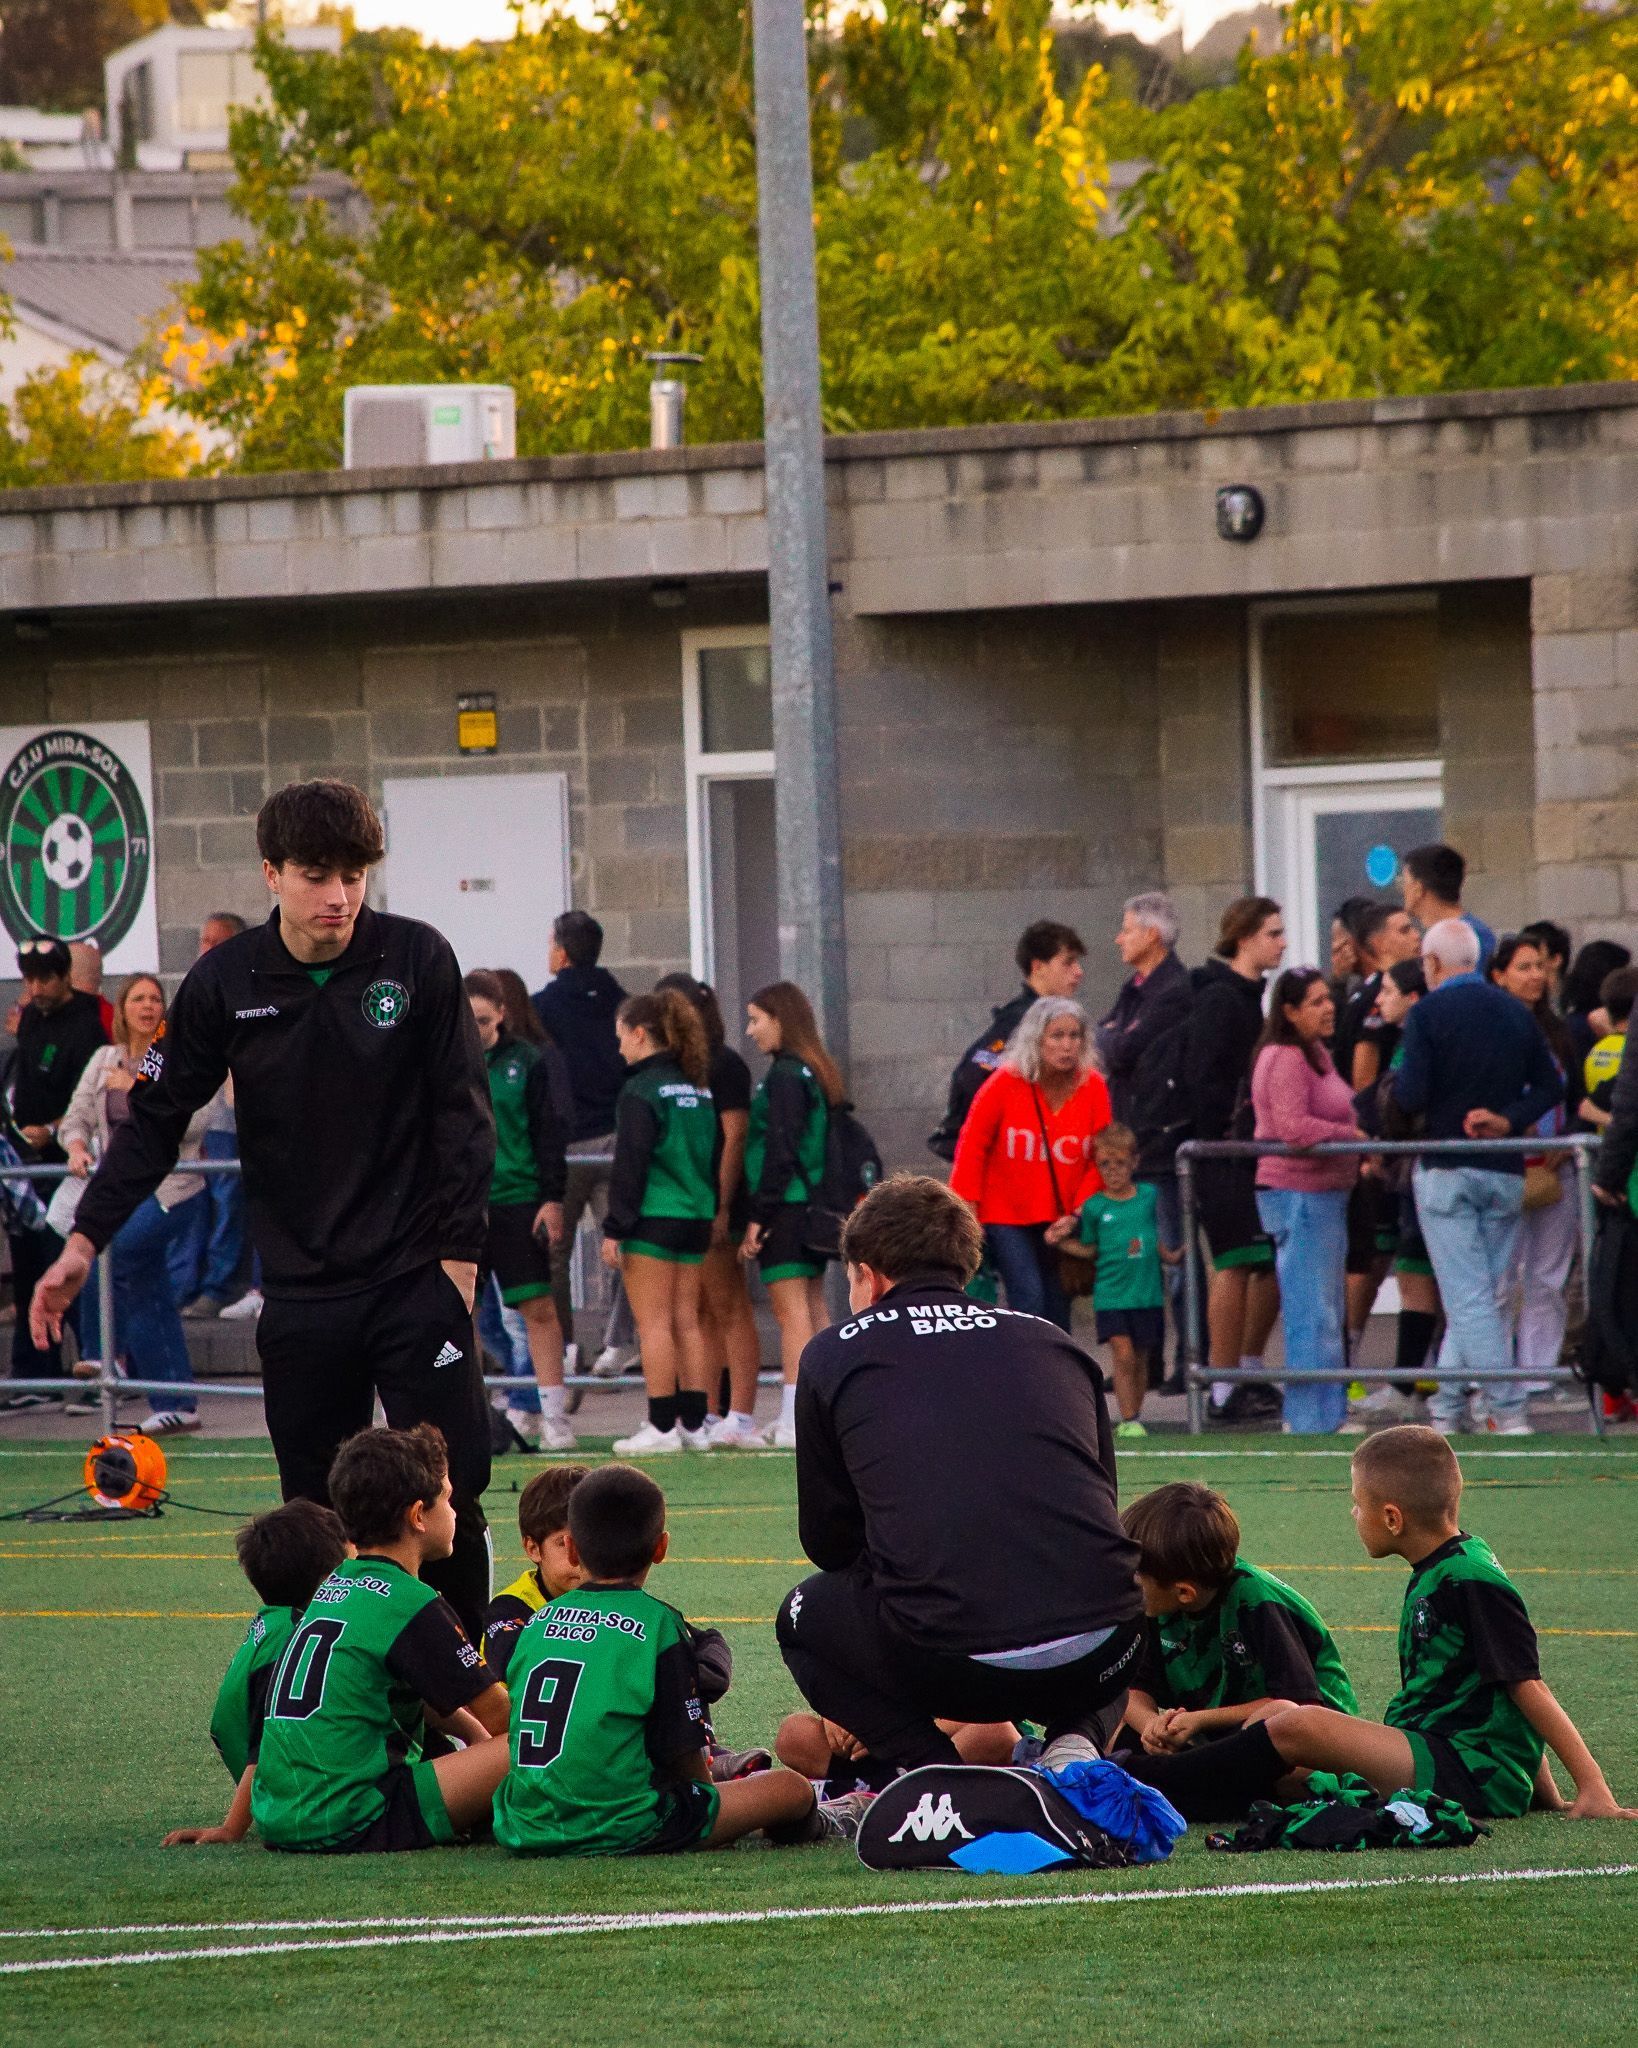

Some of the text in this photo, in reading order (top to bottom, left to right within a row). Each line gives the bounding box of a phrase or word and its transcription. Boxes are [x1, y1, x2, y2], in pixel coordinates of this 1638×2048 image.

[45, 736, 121, 783] MIRA-SOL
[839, 1309, 899, 1340] CFU
[911, 1316, 997, 1336] BACO
[313, 1587, 350, 1603] BACO
[544, 1622, 597, 1643] BACO
[552, 1606, 646, 1642] MIRA-SOL
[264, 1616, 347, 1721] 10
[517, 1657, 586, 1769] 9
